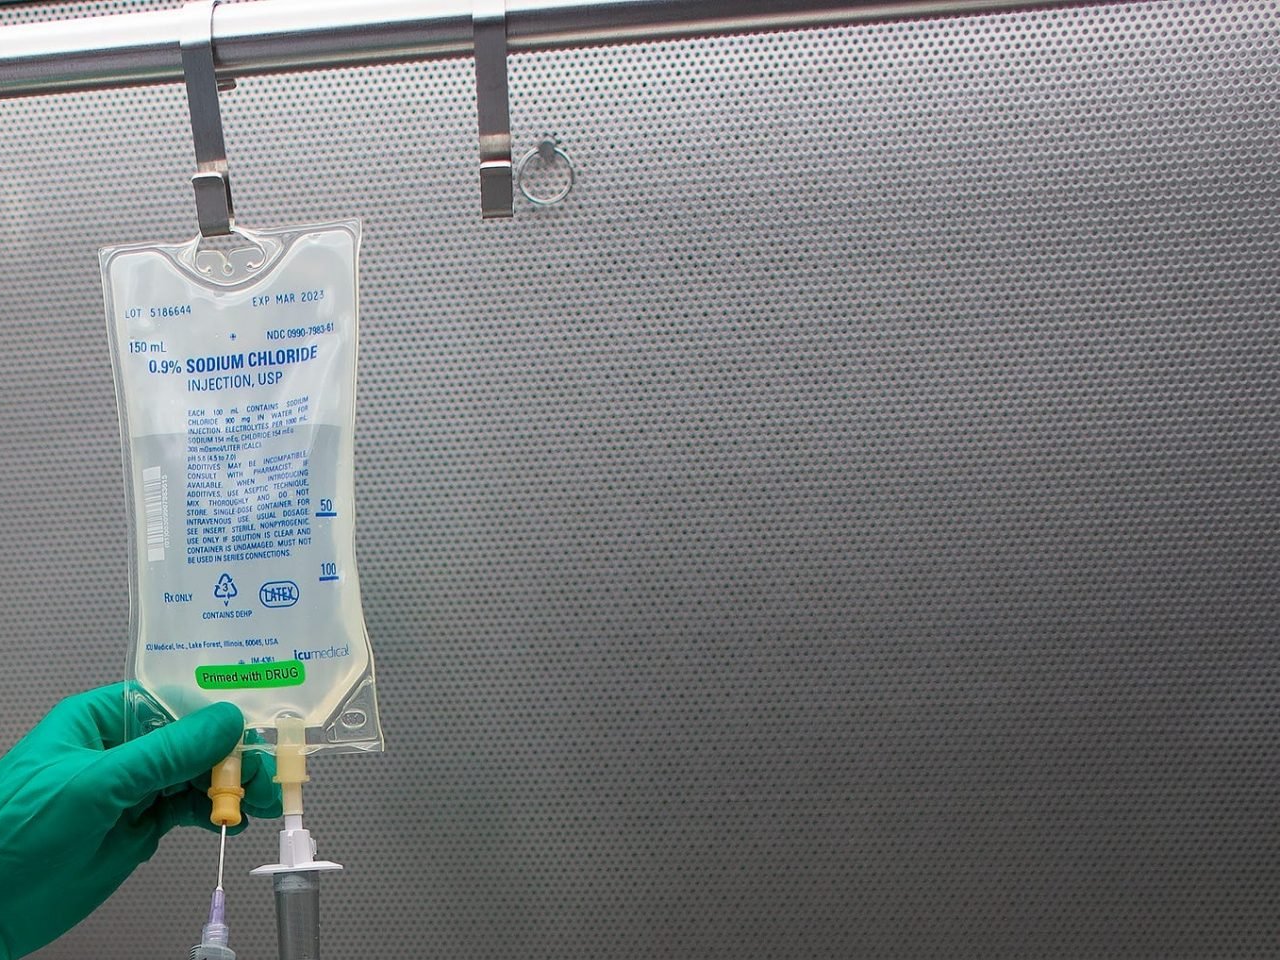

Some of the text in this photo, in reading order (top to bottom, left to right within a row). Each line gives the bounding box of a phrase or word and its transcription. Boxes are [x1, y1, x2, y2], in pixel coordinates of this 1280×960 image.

[252, 290, 324, 306] EXP MAR 2023
[125, 305, 191, 319] LOT 5186644
[267, 322, 334, 340] NDC 0990-7983-61
[130, 341, 167, 353] 150 mL
[149, 345, 318, 374] 0.9% SODIUM CHLORIDE
[188, 371, 283, 392] INJECTION, USP
[246, 403, 279, 413] CONTAINS
[287, 396, 309, 407] SODIUM
[188, 418, 218, 426] CHLORIDE
[271, 409, 292, 419] WATER
[298, 405, 308, 413] FOR
[225, 422, 269, 433] ELECTROLYTES
[272, 420, 283, 428] PER
[241, 430, 270, 441] CHLORIDE
[187, 463, 221, 471] ADDITIVES
[237, 478, 255, 486] WHEN
[267, 469, 308, 481] INTRODUCING
[209, 498, 248, 506] THOROUGHLY
[257, 493, 270, 501] AND
[296, 488, 309, 496] NOT
[227, 489, 238, 497] USE
[244, 484, 269, 495] ASEPTIC
[213, 504, 253, 516] SINGLE-DOSE
[257, 500, 292, 511] CONTAINER
[297, 498, 310, 506] FOR
[320, 499, 332, 512] 50
[187, 518, 232, 526] INTRAVENOUS
[256, 511, 276, 520] USUAL
[282, 508, 308, 518] DOSAGE
[187, 528, 198, 536] SEE
[187, 537, 199, 545] USE
[231, 532, 261, 543] SOLUTION
[264, 531, 271, 539] IS
[274, 528, 294, 538] CLEAR
[296, 527, 311, 536] AND
[187, 545, 223, 555] CONTAINER
[225, 544, 232, 552] IS
[277, 539, 296, 547] MUST
[298, 537, 312, 546] NOT
[187, 556, 196, 564] BE
[196, 555, 214, 563] USED
[214, 554, 222, 562] IN
[223, 552, 244, 562] SERIES
[321, 563, 337, 575] 100
[222, 583, 229, 592] 3
[265, 587, 293, 602] LATEX
[164, 592, 193, 603] Rx ONLY
[202, 610, 253, 620] CONTAINS DEHP
[188, 641, 202, 649] Lake
[203, 640, 223, 648] Forest,
[245, 638, 264, 647] 60045,
[264, 638, 279, 646] USA
[202, 667, 299, 683] Primed with DRUG
